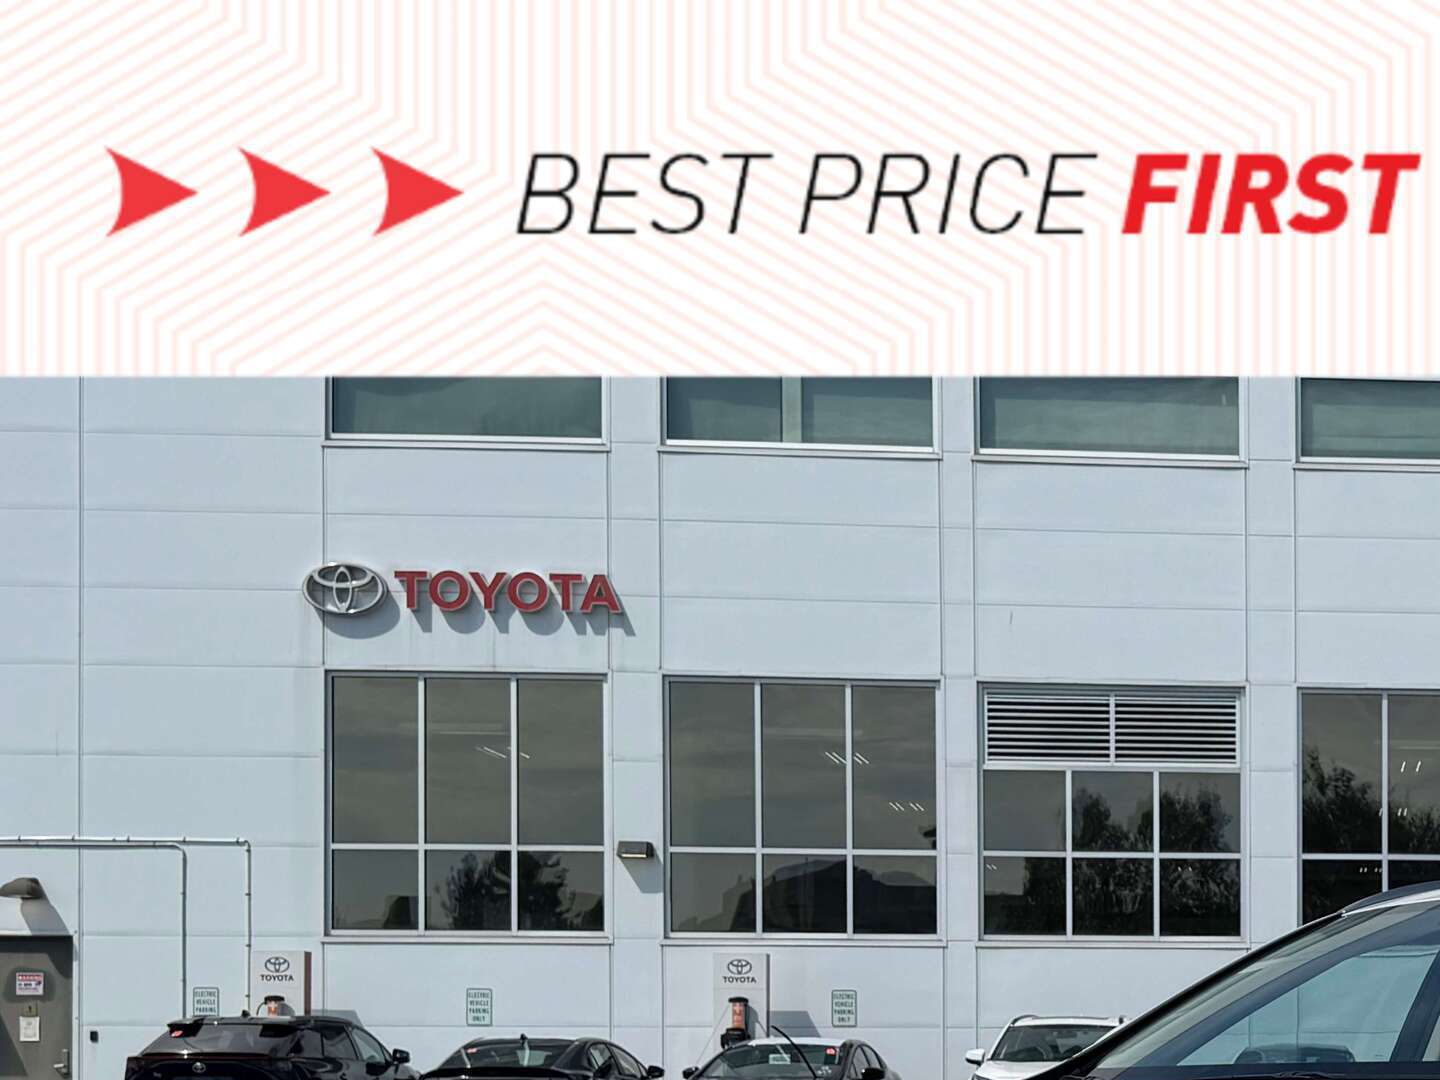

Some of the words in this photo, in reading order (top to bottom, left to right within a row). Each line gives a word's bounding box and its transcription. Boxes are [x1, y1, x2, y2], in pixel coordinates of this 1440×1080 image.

[394, 570, 624, 615] TOYOTA
[260, 974, 294, 982] TOYOTA
[722, 976, 757, 984] TOYOTA
